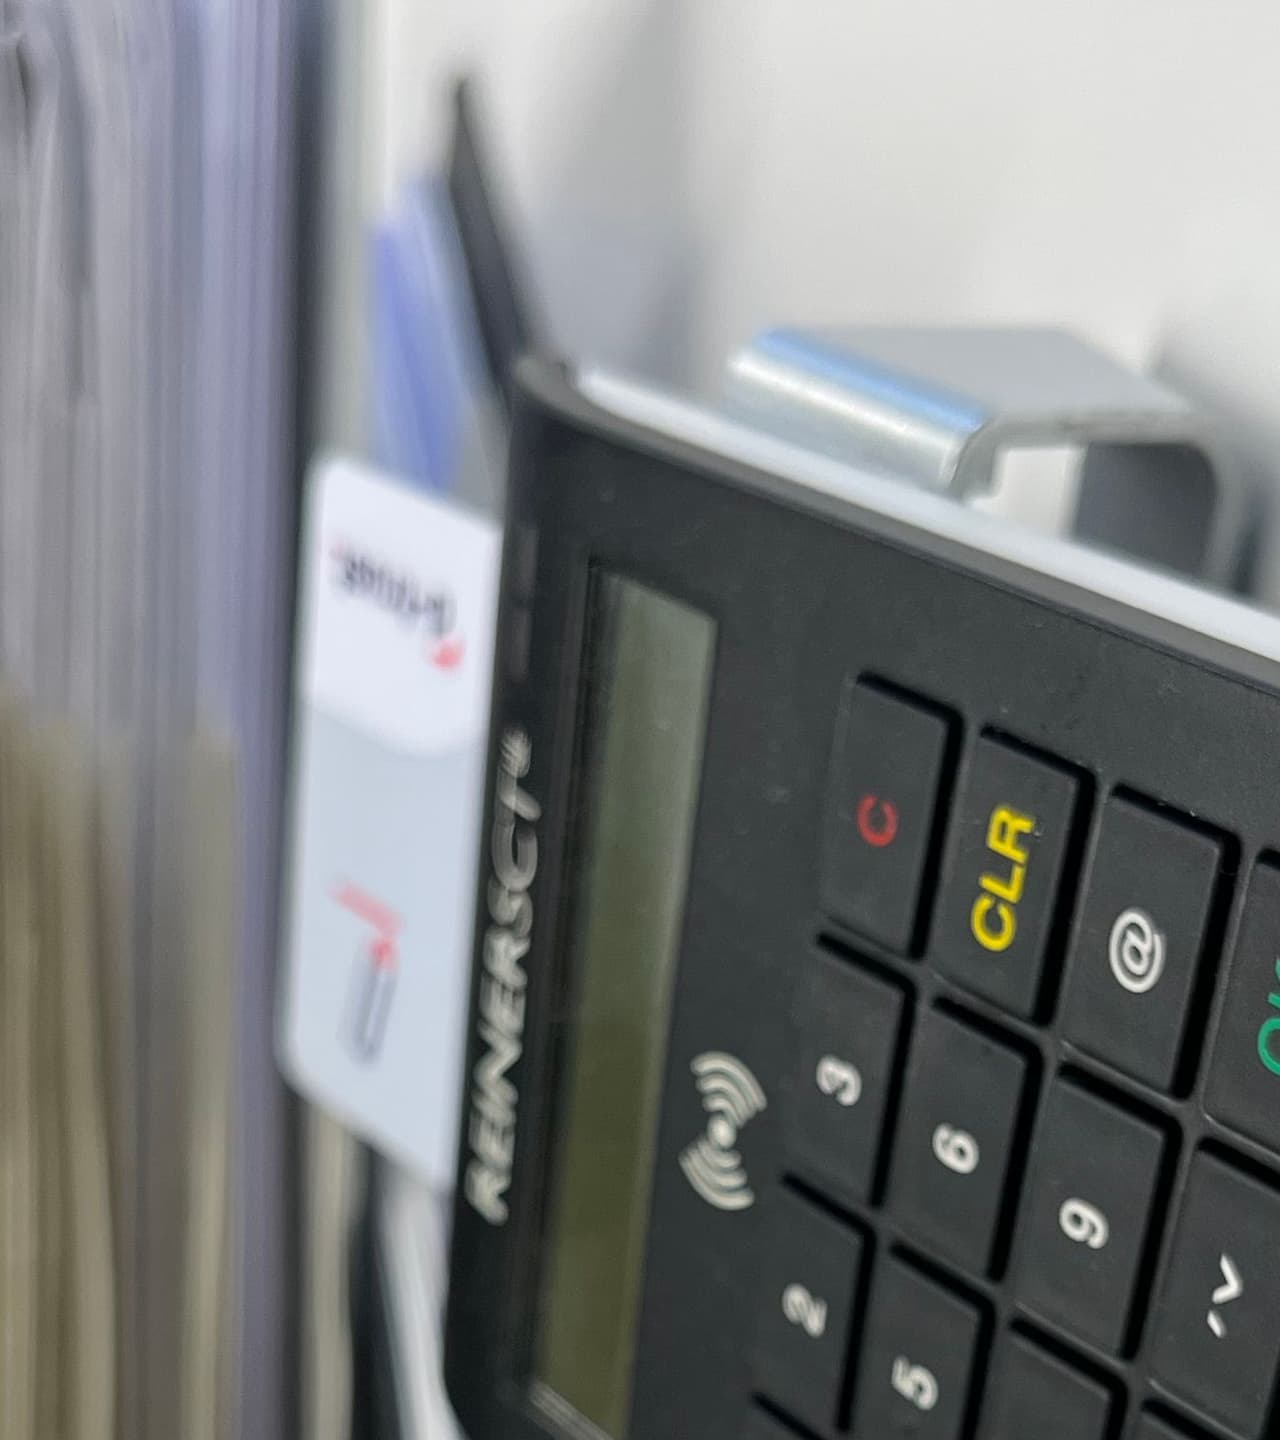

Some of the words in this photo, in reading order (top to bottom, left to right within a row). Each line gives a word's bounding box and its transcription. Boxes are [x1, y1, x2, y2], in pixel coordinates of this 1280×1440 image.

[857, 795, 898, 847] C
[970, 807, 1036, 953] CLR
[816, 1055, 862, 1107] 3
[932, 1124, 980, 1176] 6
[1059, 1198, 1109, 1250] 9
[782, 1284, 828, 1338] 2
[891, 1357, 939, 1411] 5
